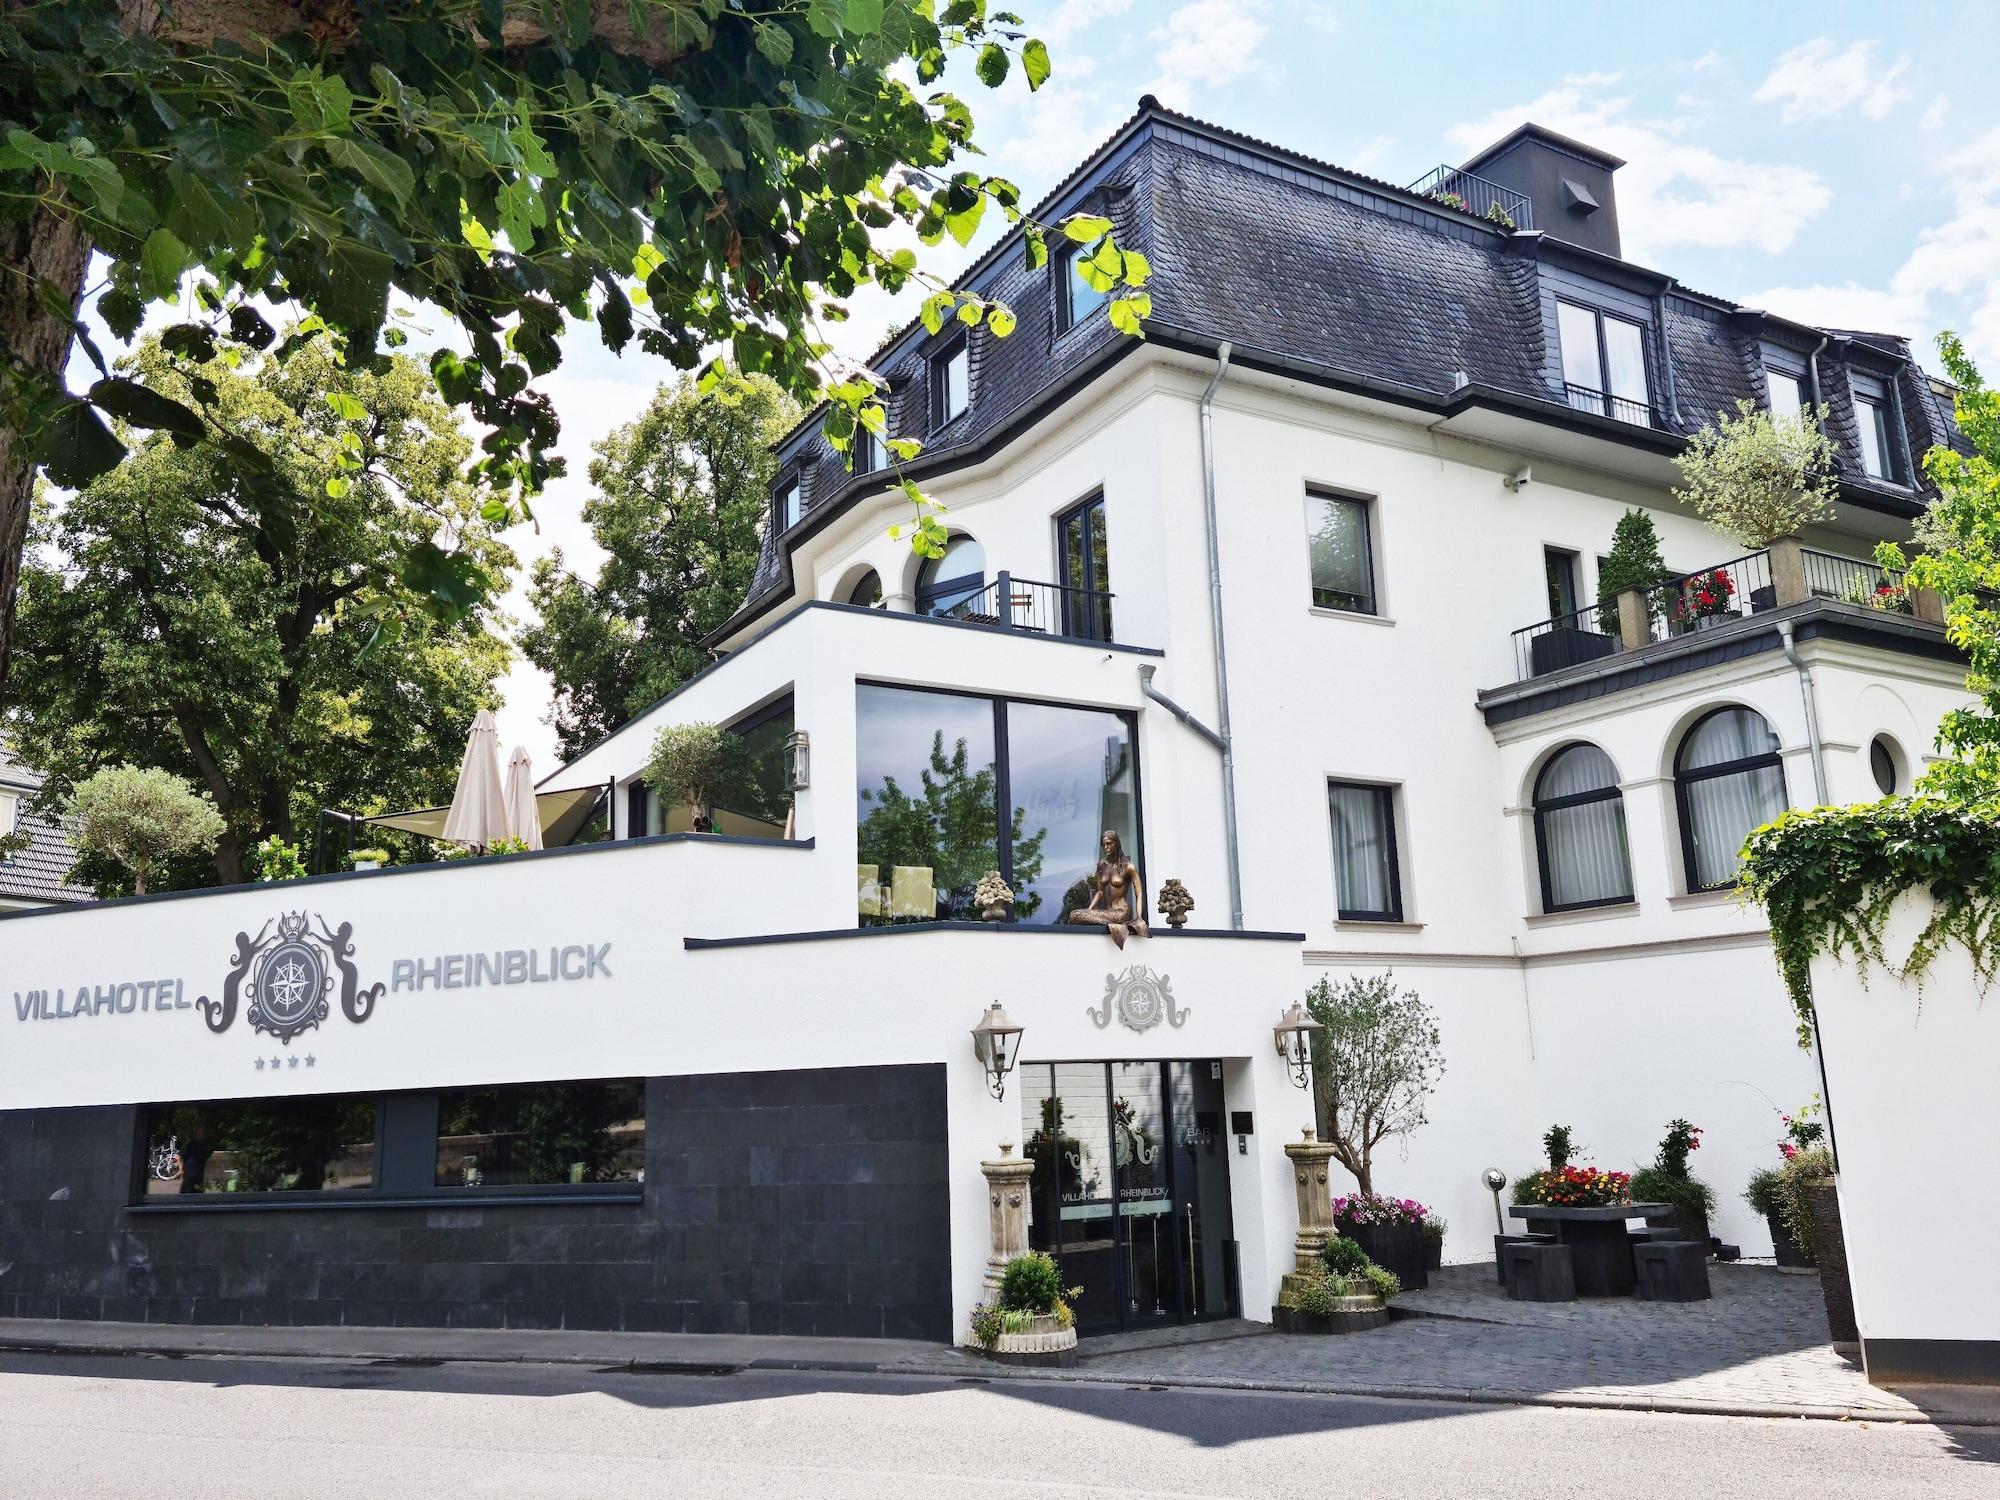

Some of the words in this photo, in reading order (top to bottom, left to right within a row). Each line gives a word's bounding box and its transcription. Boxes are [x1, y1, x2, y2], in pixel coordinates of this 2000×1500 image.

[13, 977, 192, 1022] VILLAHOTEL
[391, 942, 613, 993] RHEINBLICK
[1187, 1127, 1210, 1137] BAR
[1062, 1190, 1105, 1202] VILLAHO
[1121, 1186, 1165, 1198] RHEINBLICK
